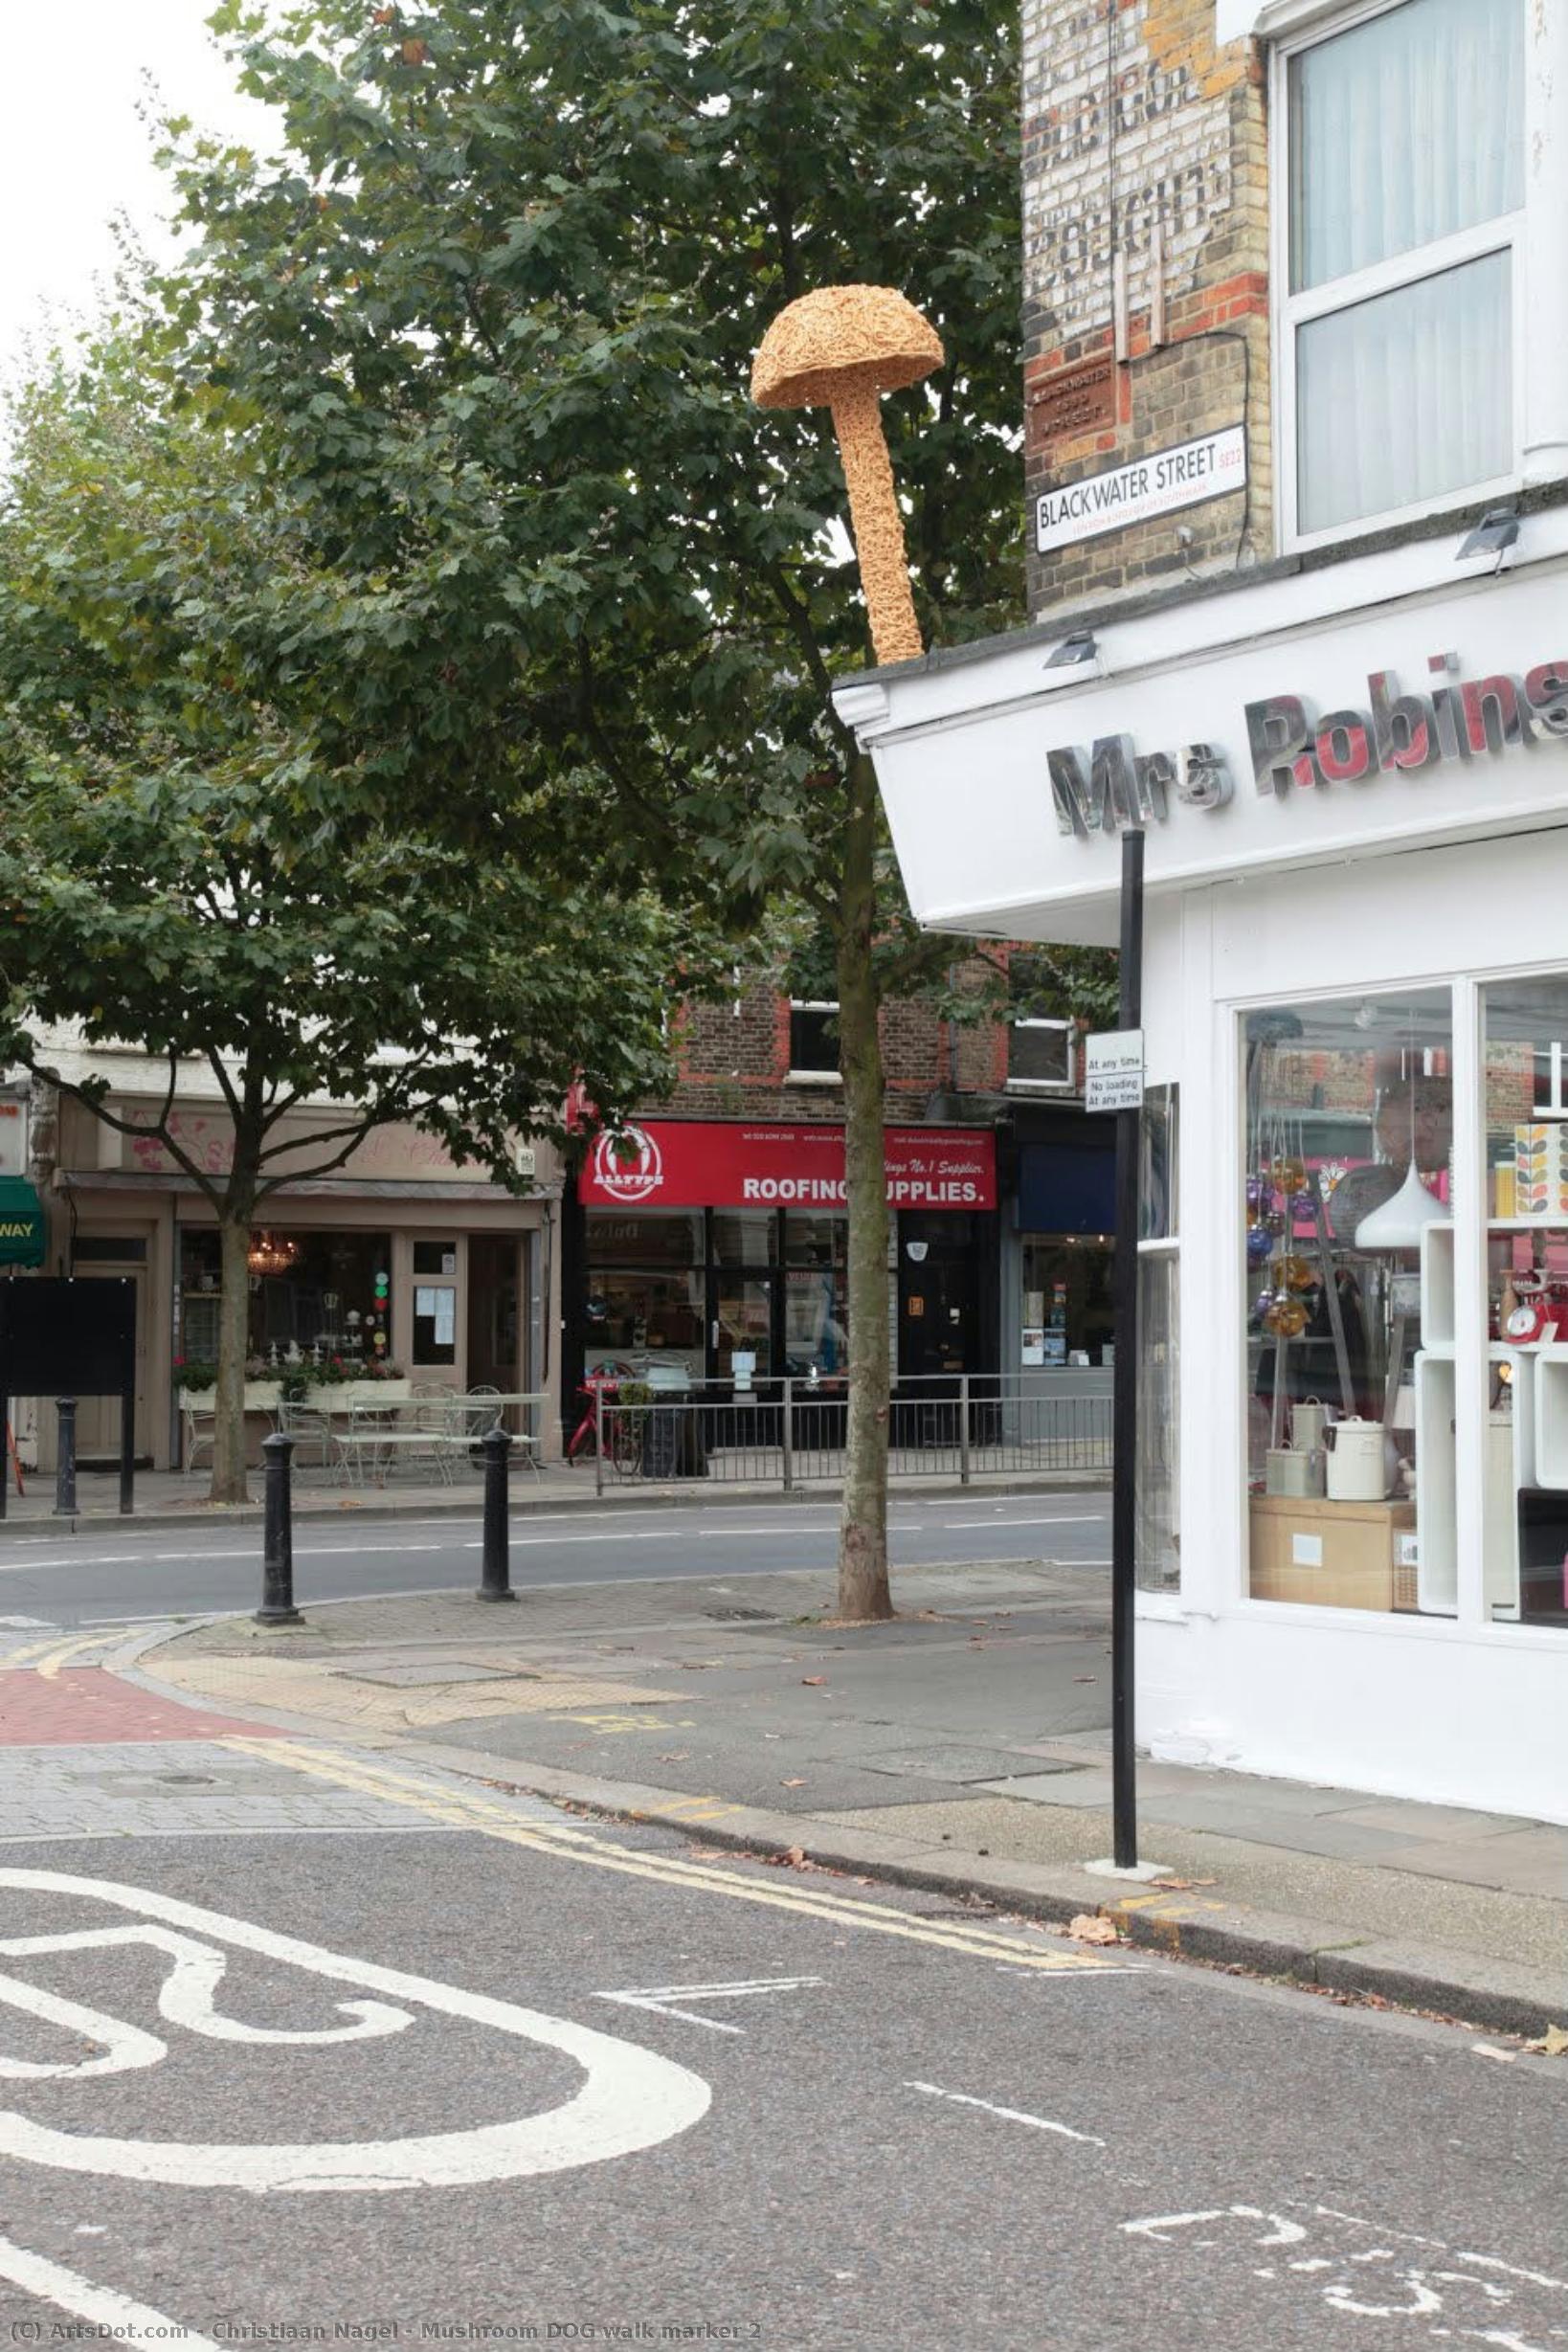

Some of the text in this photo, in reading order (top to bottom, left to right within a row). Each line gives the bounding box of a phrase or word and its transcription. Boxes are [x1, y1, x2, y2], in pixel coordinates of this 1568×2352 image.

[1041, 467, 1149, 528] BLACKWATER
[1156, 443, 1216, 489] STREET
[1046, 733, 1234, 836] Mrs
[1088, 1056, 1140, 1070] At any time
[1091, 1079, 1138, 1091] No loading
[1088, 1092, 1140, 1106] At any time
[885, 1180, 985, 1202] PPLIES.
